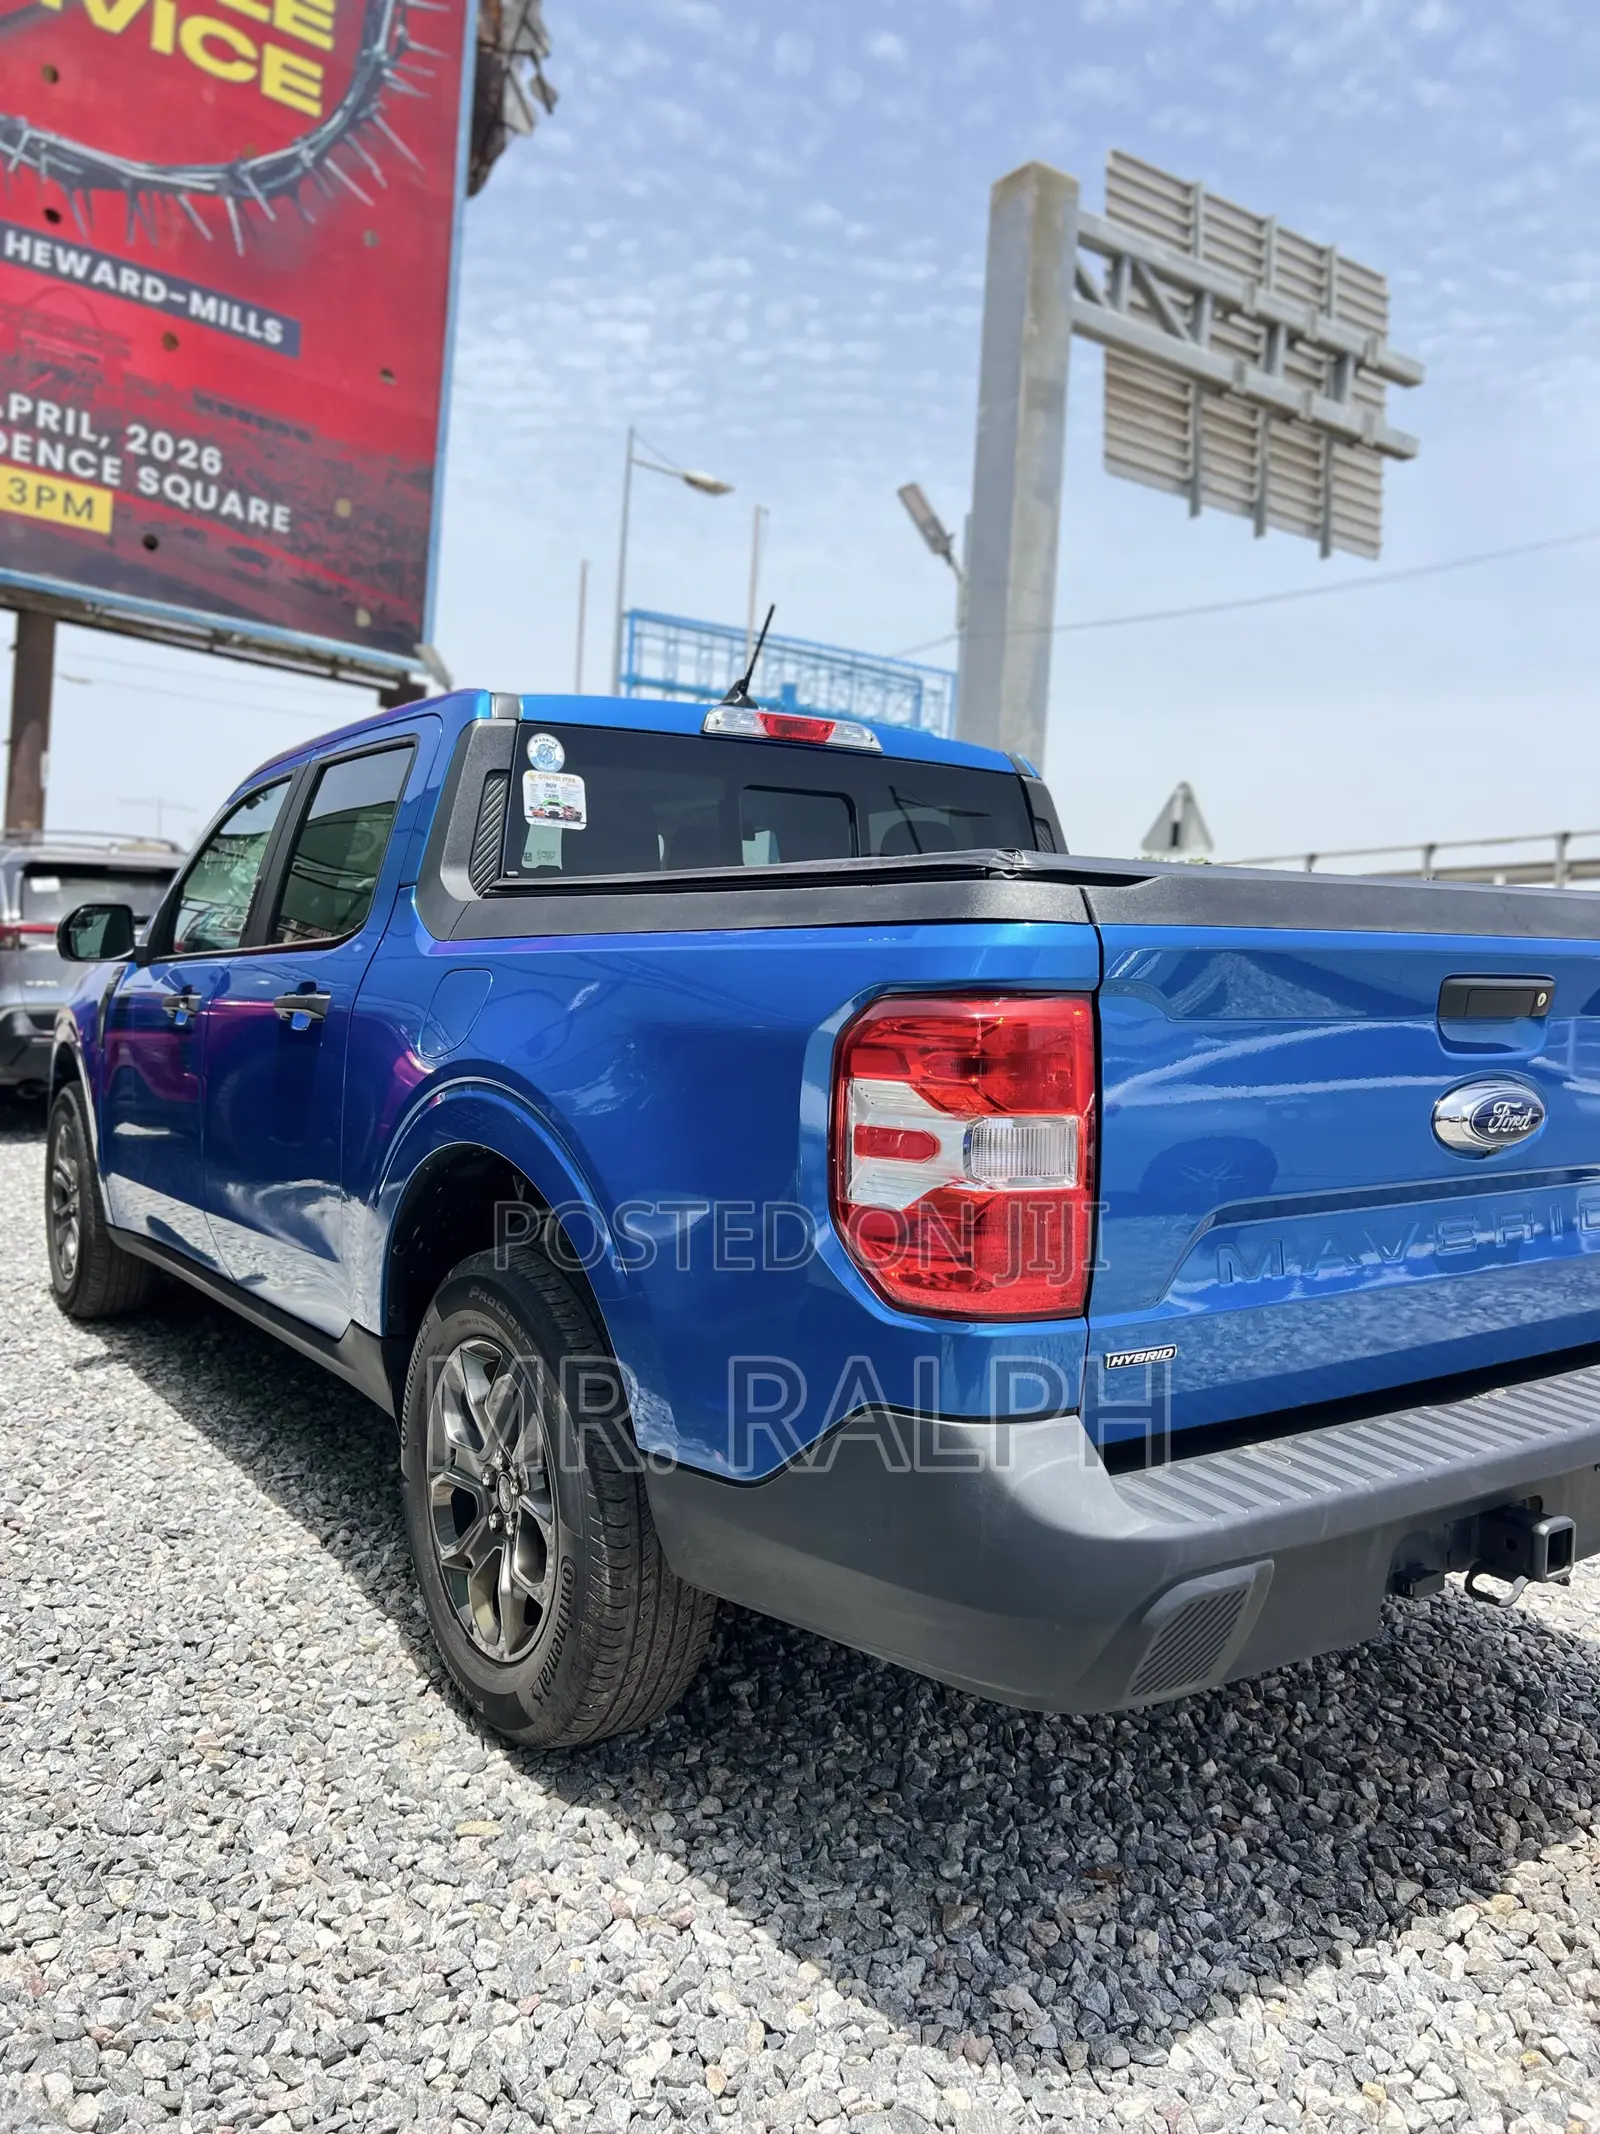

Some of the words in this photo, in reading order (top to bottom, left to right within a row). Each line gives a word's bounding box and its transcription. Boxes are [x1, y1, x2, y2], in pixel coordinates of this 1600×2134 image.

[40, 0, 324, 118] VICE
[5, 229, 284, 347] HEWARD-MILLS
[0, 392, 110, 449] PRIL,
[125, 424, 224, 476] 2026
[7, 476, 94, 522] 3PM
[137, 467, 291, 534] SQUARE
[1488, 1101, 1532, 1133] Ford
[1110, 1347, 1174, 1366] HYBRID
